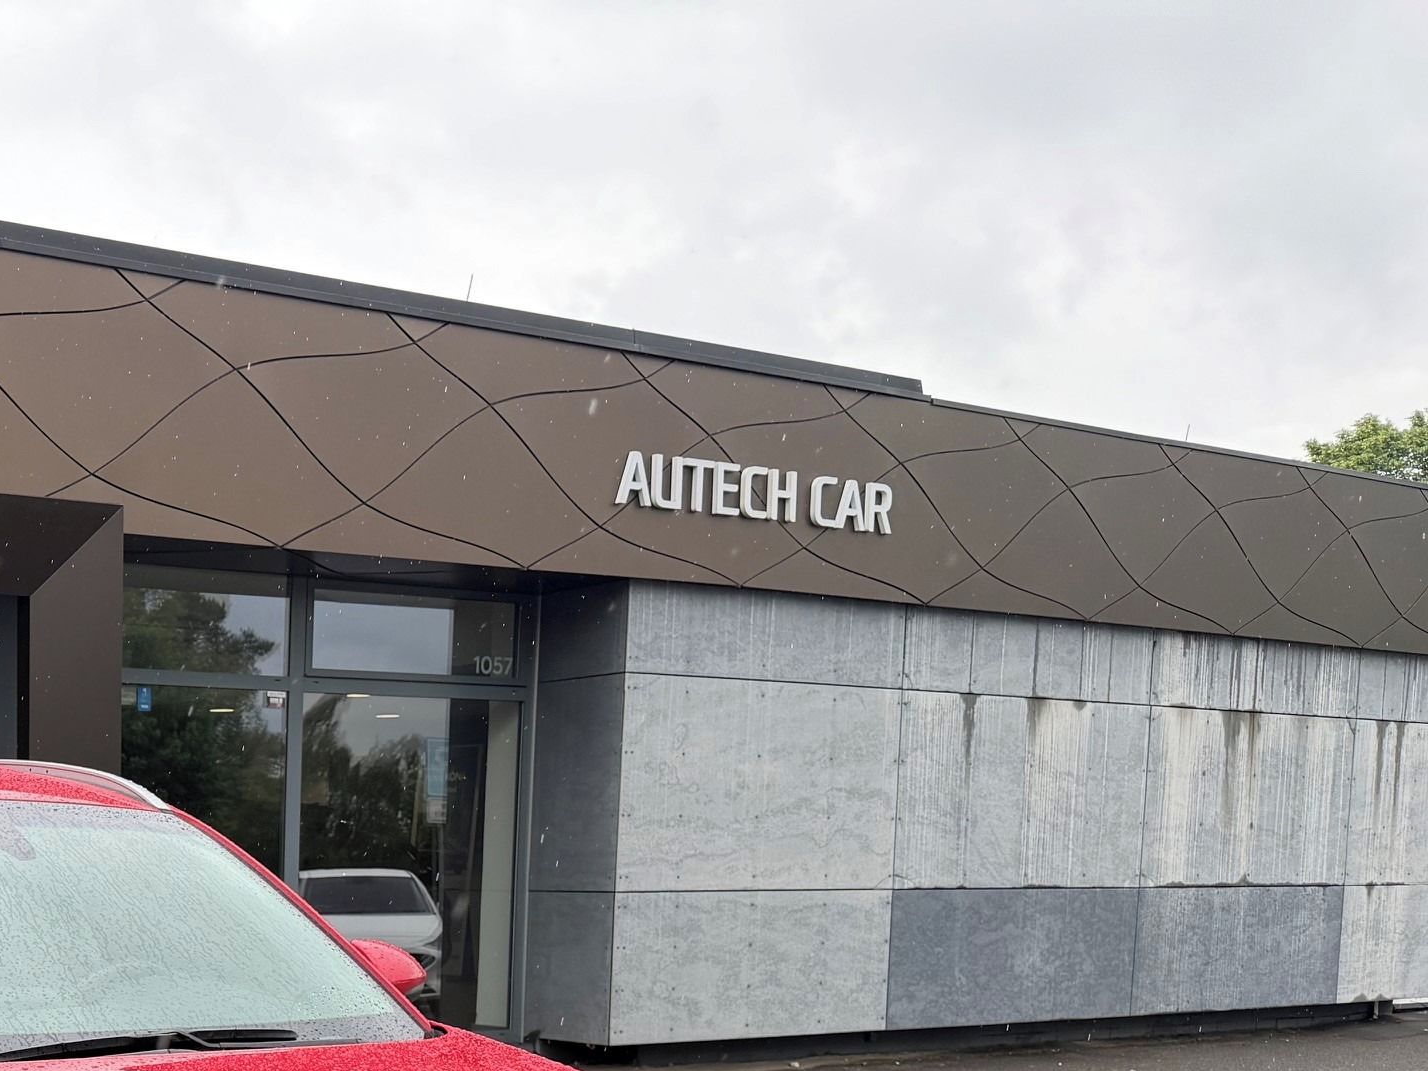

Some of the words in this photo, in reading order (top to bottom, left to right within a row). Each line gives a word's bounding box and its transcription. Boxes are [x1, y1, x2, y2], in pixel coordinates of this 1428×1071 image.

[614, 450, 798, 523] AUTECH
[810, 475, 893, 535] CAR
[474, 655, 513, 675] 1057
